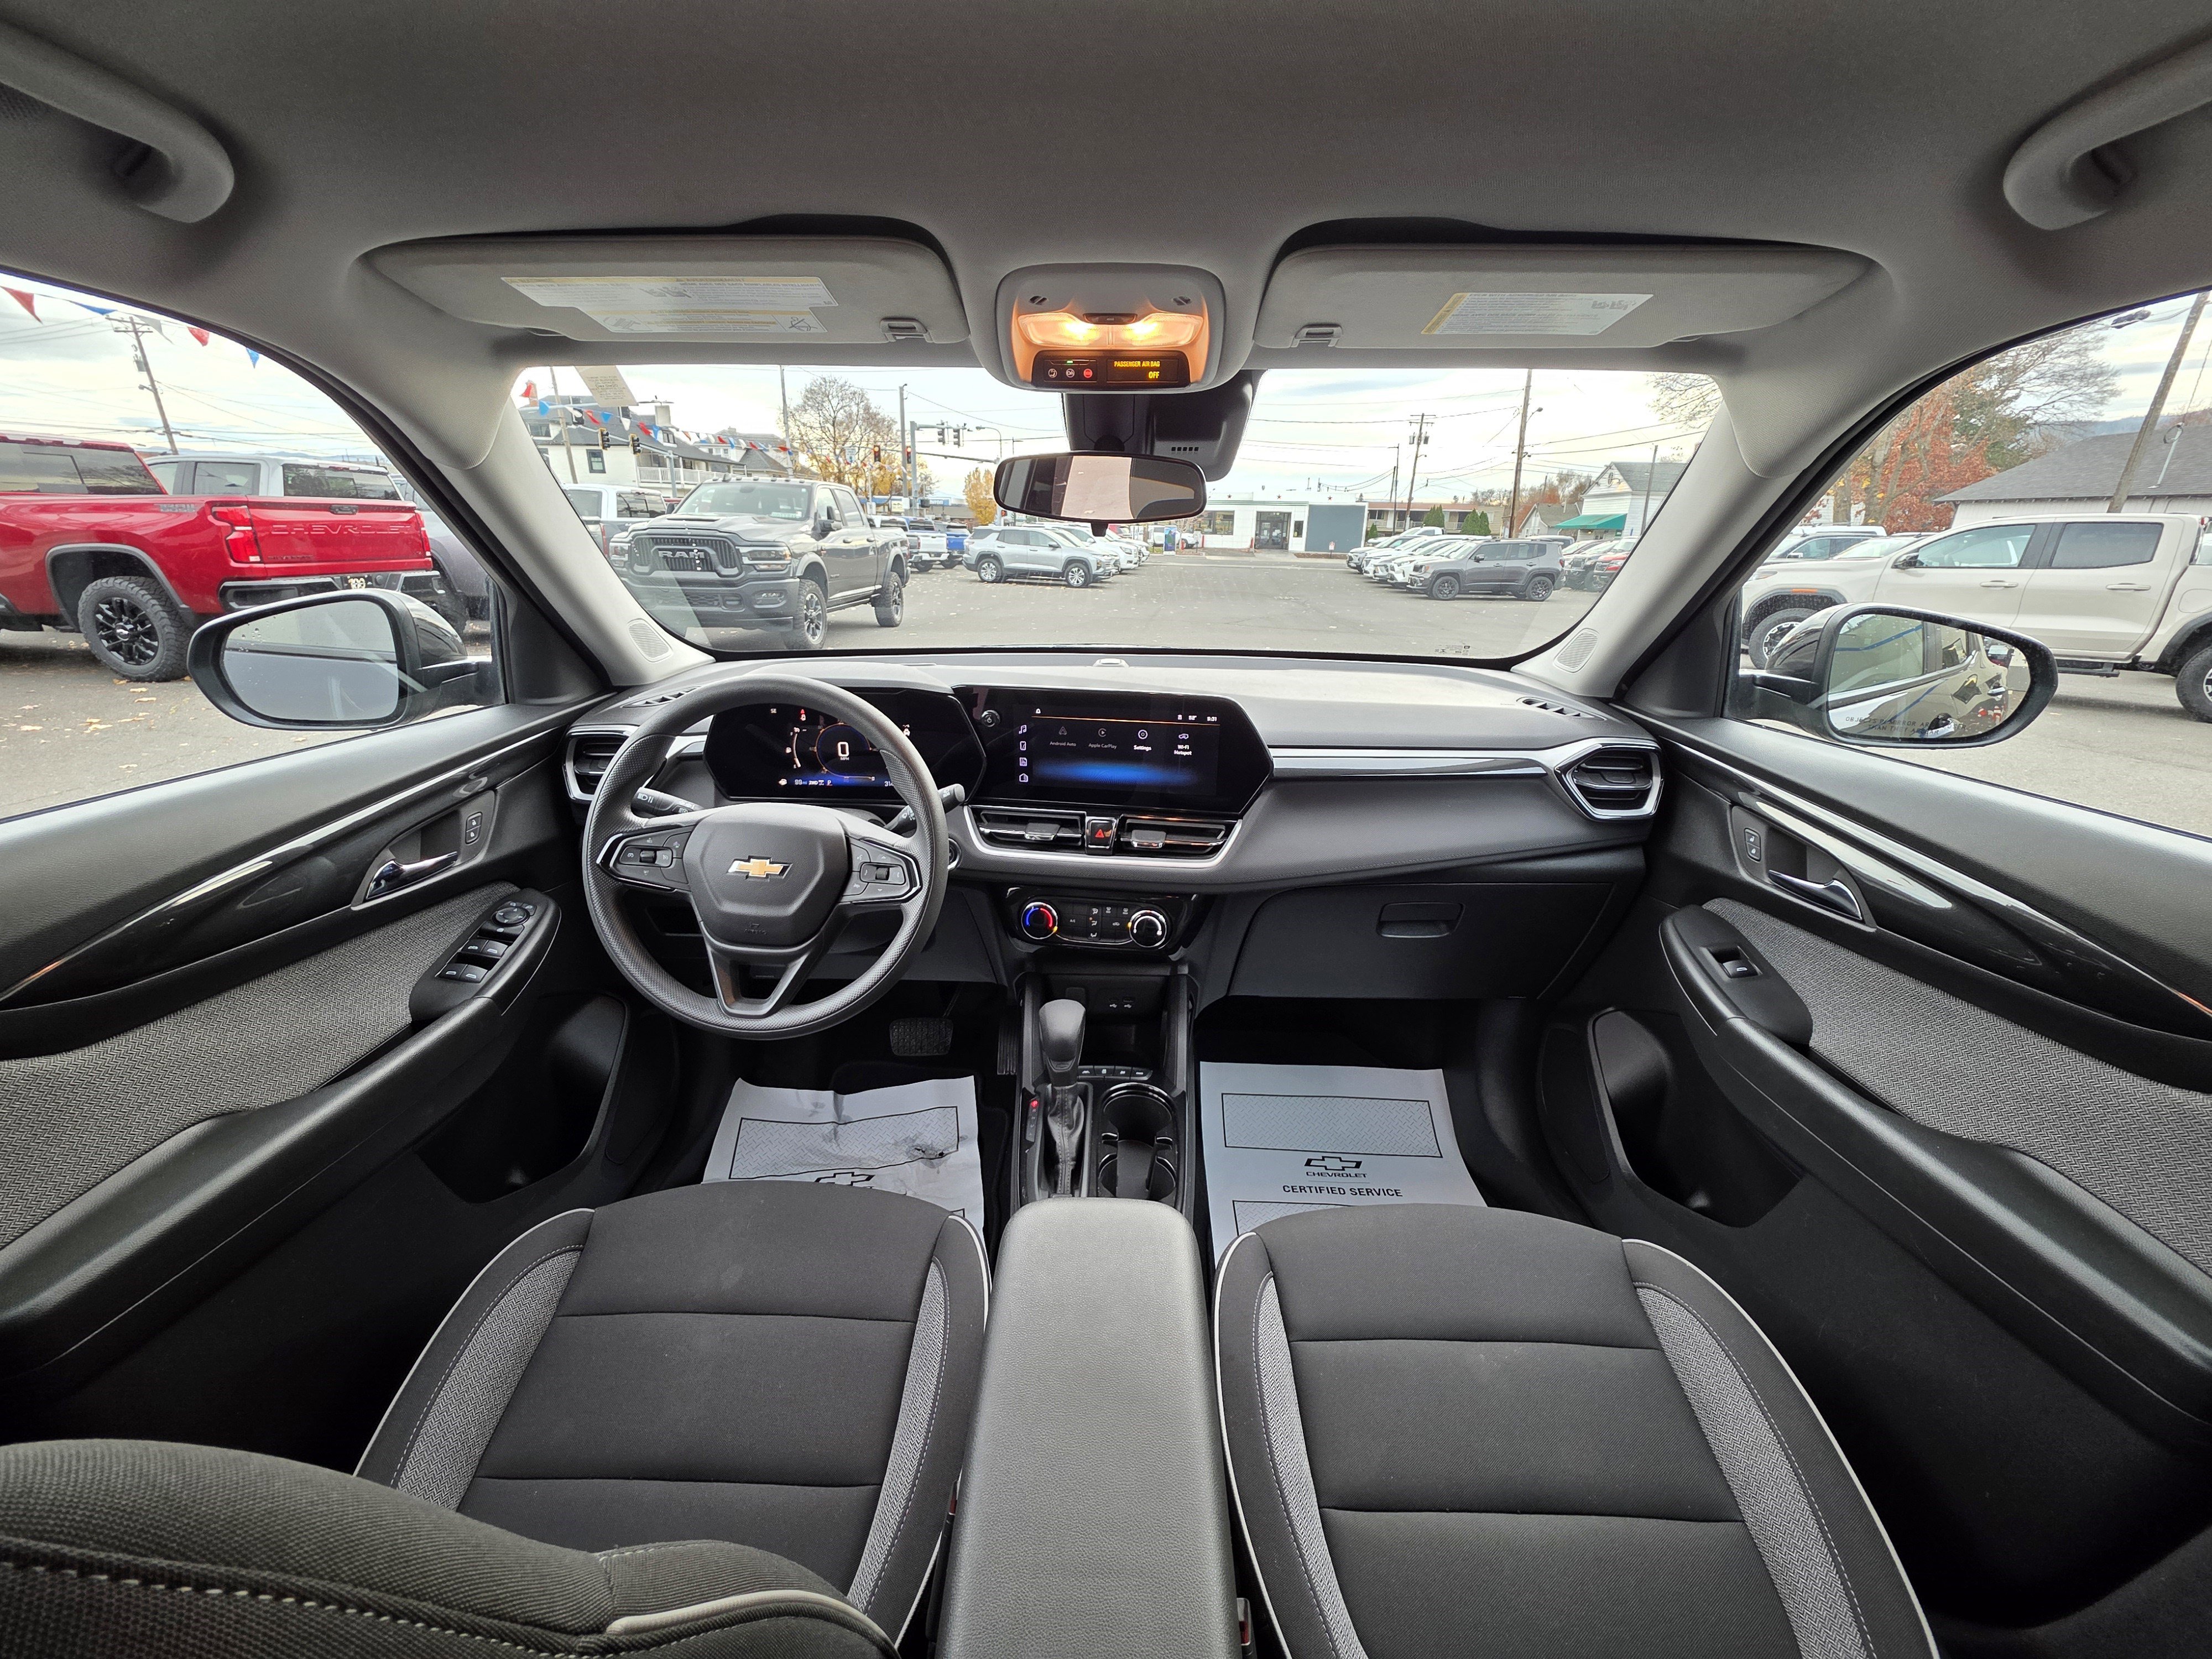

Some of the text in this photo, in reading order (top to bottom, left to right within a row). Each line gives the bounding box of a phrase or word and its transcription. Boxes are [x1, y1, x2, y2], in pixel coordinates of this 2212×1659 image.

[271, 525, 411, 535] CHEVROLET
[837, 742, 849, 757] 0
[1282, 1185, 1404, 1197] CERTIFIED SERVICE
